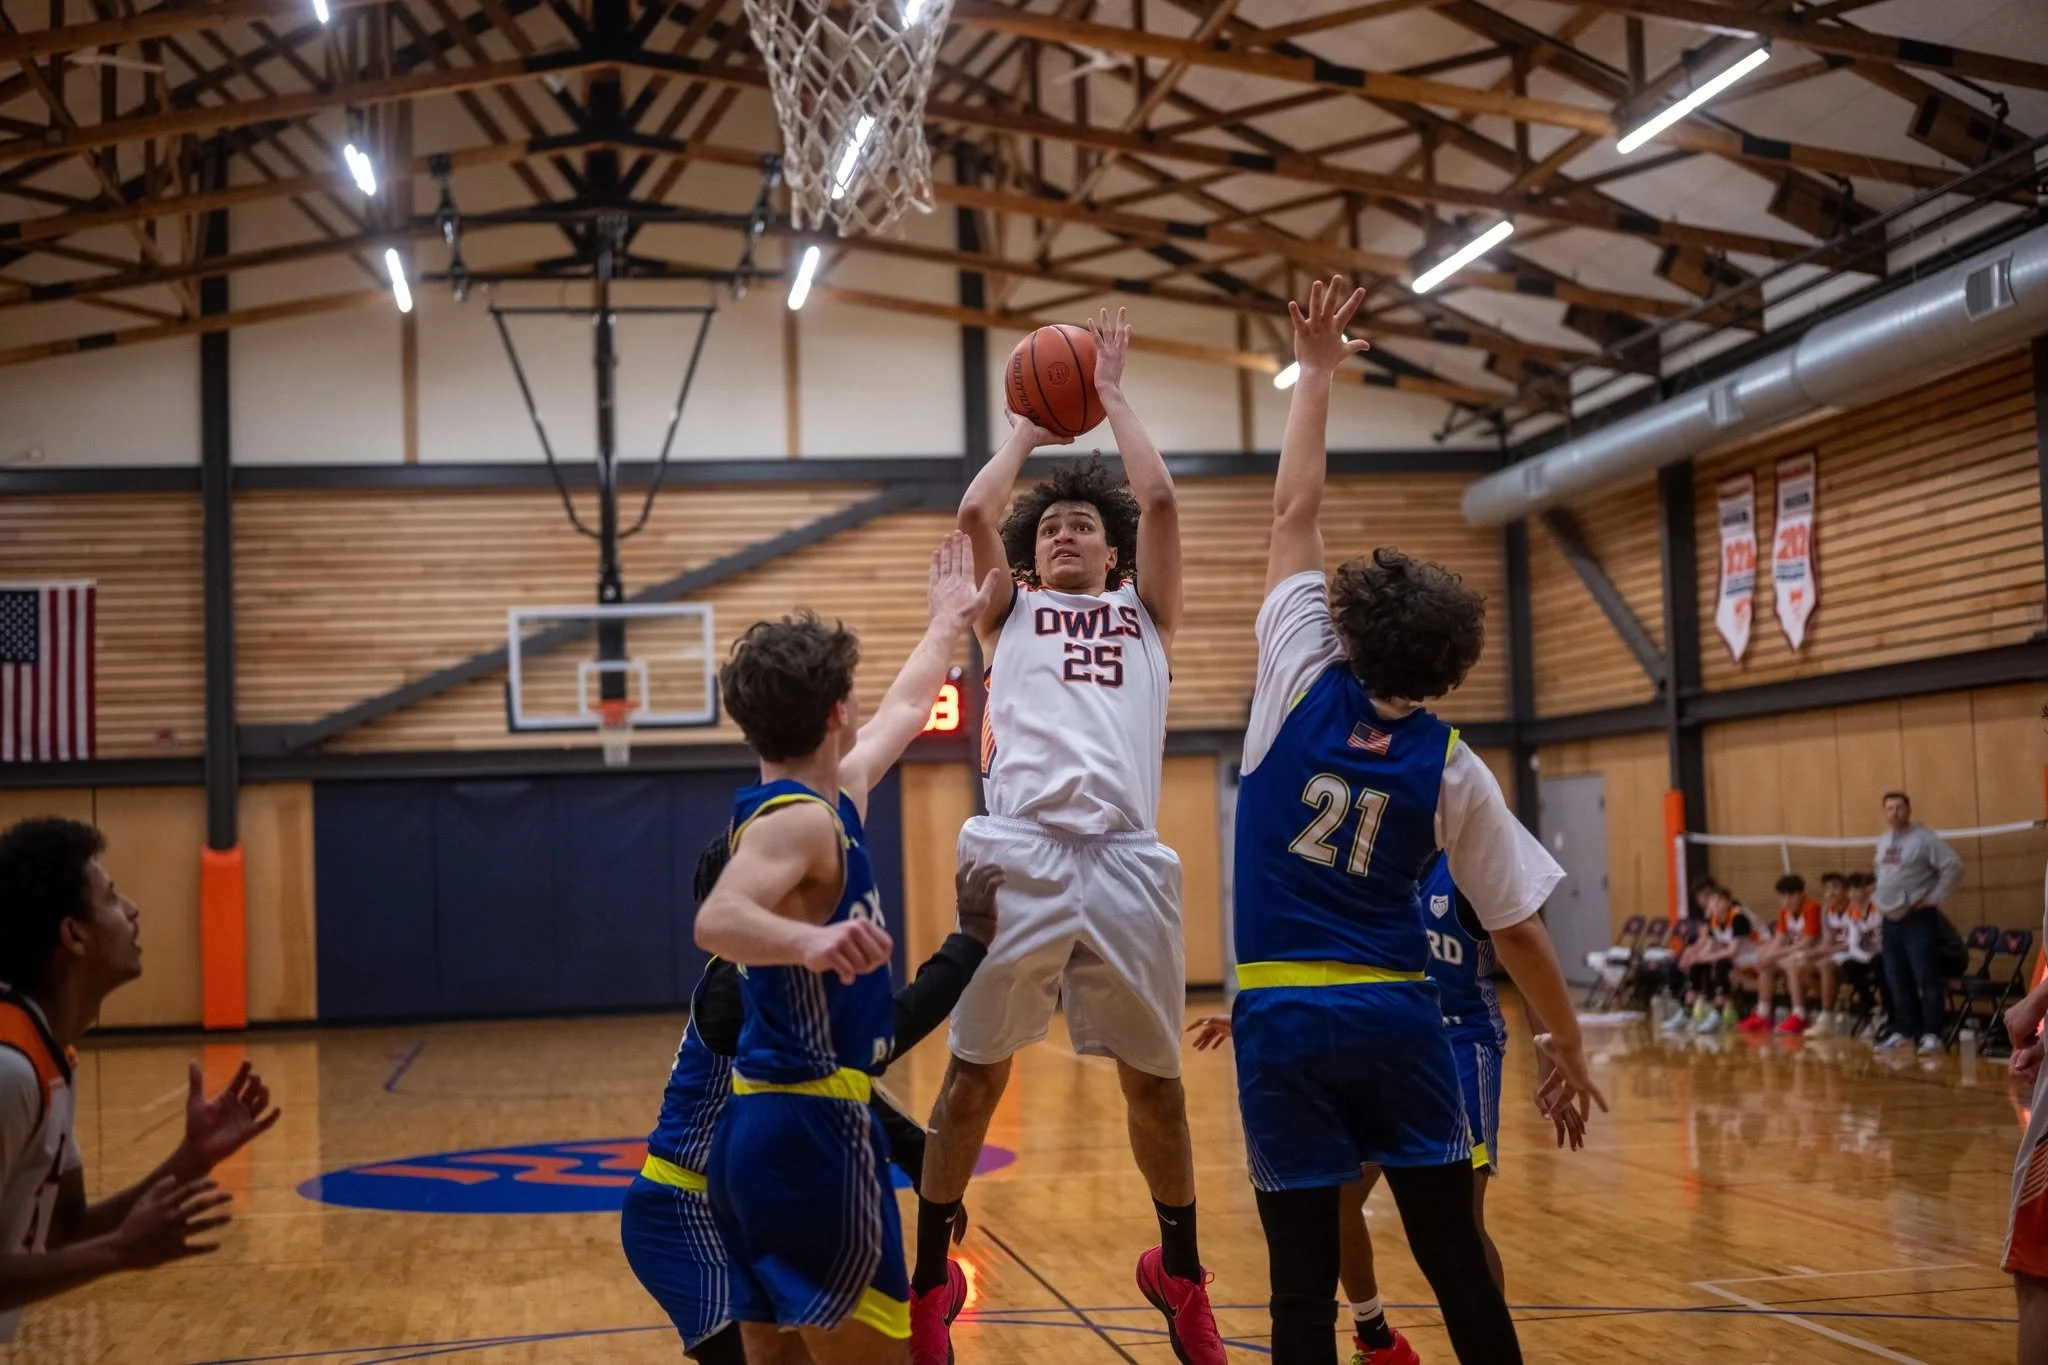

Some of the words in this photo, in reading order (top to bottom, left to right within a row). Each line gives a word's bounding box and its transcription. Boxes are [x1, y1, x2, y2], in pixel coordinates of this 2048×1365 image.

[1035, 604, 1141, 640] OWLS
[1063, 642, 1123, 688] 25
[1288, 772, 1390, 877] 21
